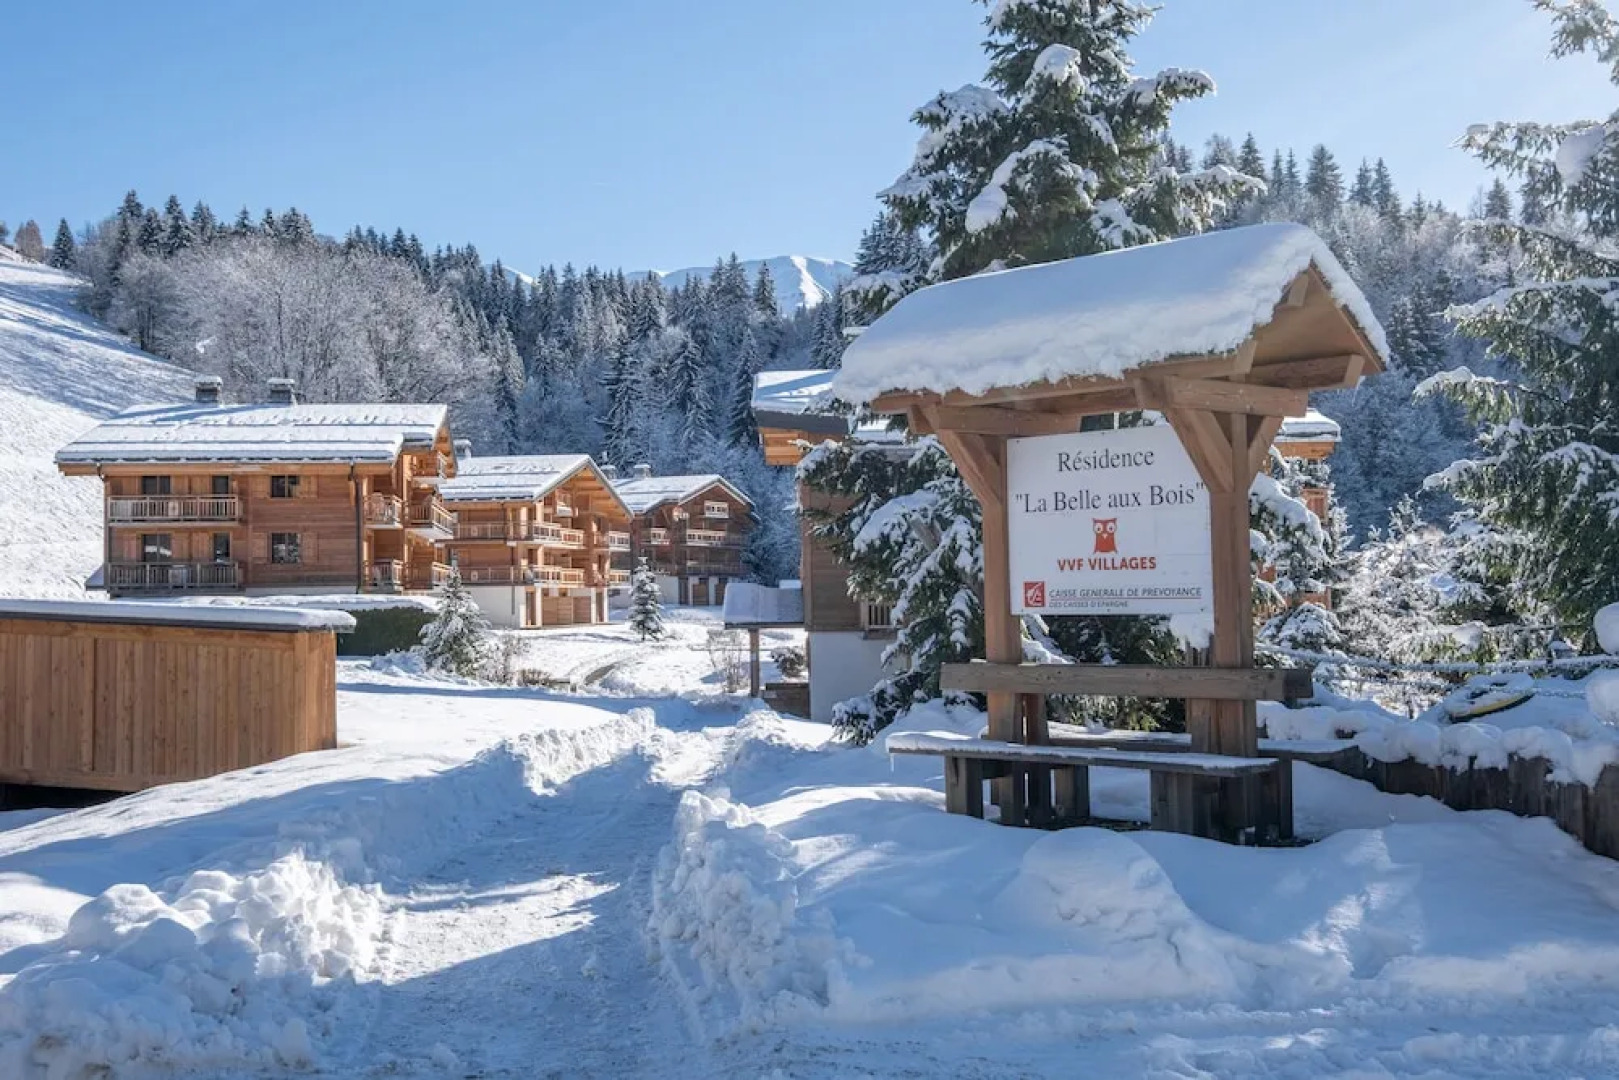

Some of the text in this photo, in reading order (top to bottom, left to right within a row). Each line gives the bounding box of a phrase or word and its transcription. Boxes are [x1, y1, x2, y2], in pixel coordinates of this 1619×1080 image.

[1058, 448, 1155, 472] Résidence
[1015, 482, 1204, 514] "La Belle aux Bois"
[1057, 556, 1157, 571] VVF VILLAGES
[1048, 588, 1076, 597] CAISSE
[1127, 587, 1139, 597] DE
[1142, 587, 1202, 597] PREVOYANCE
